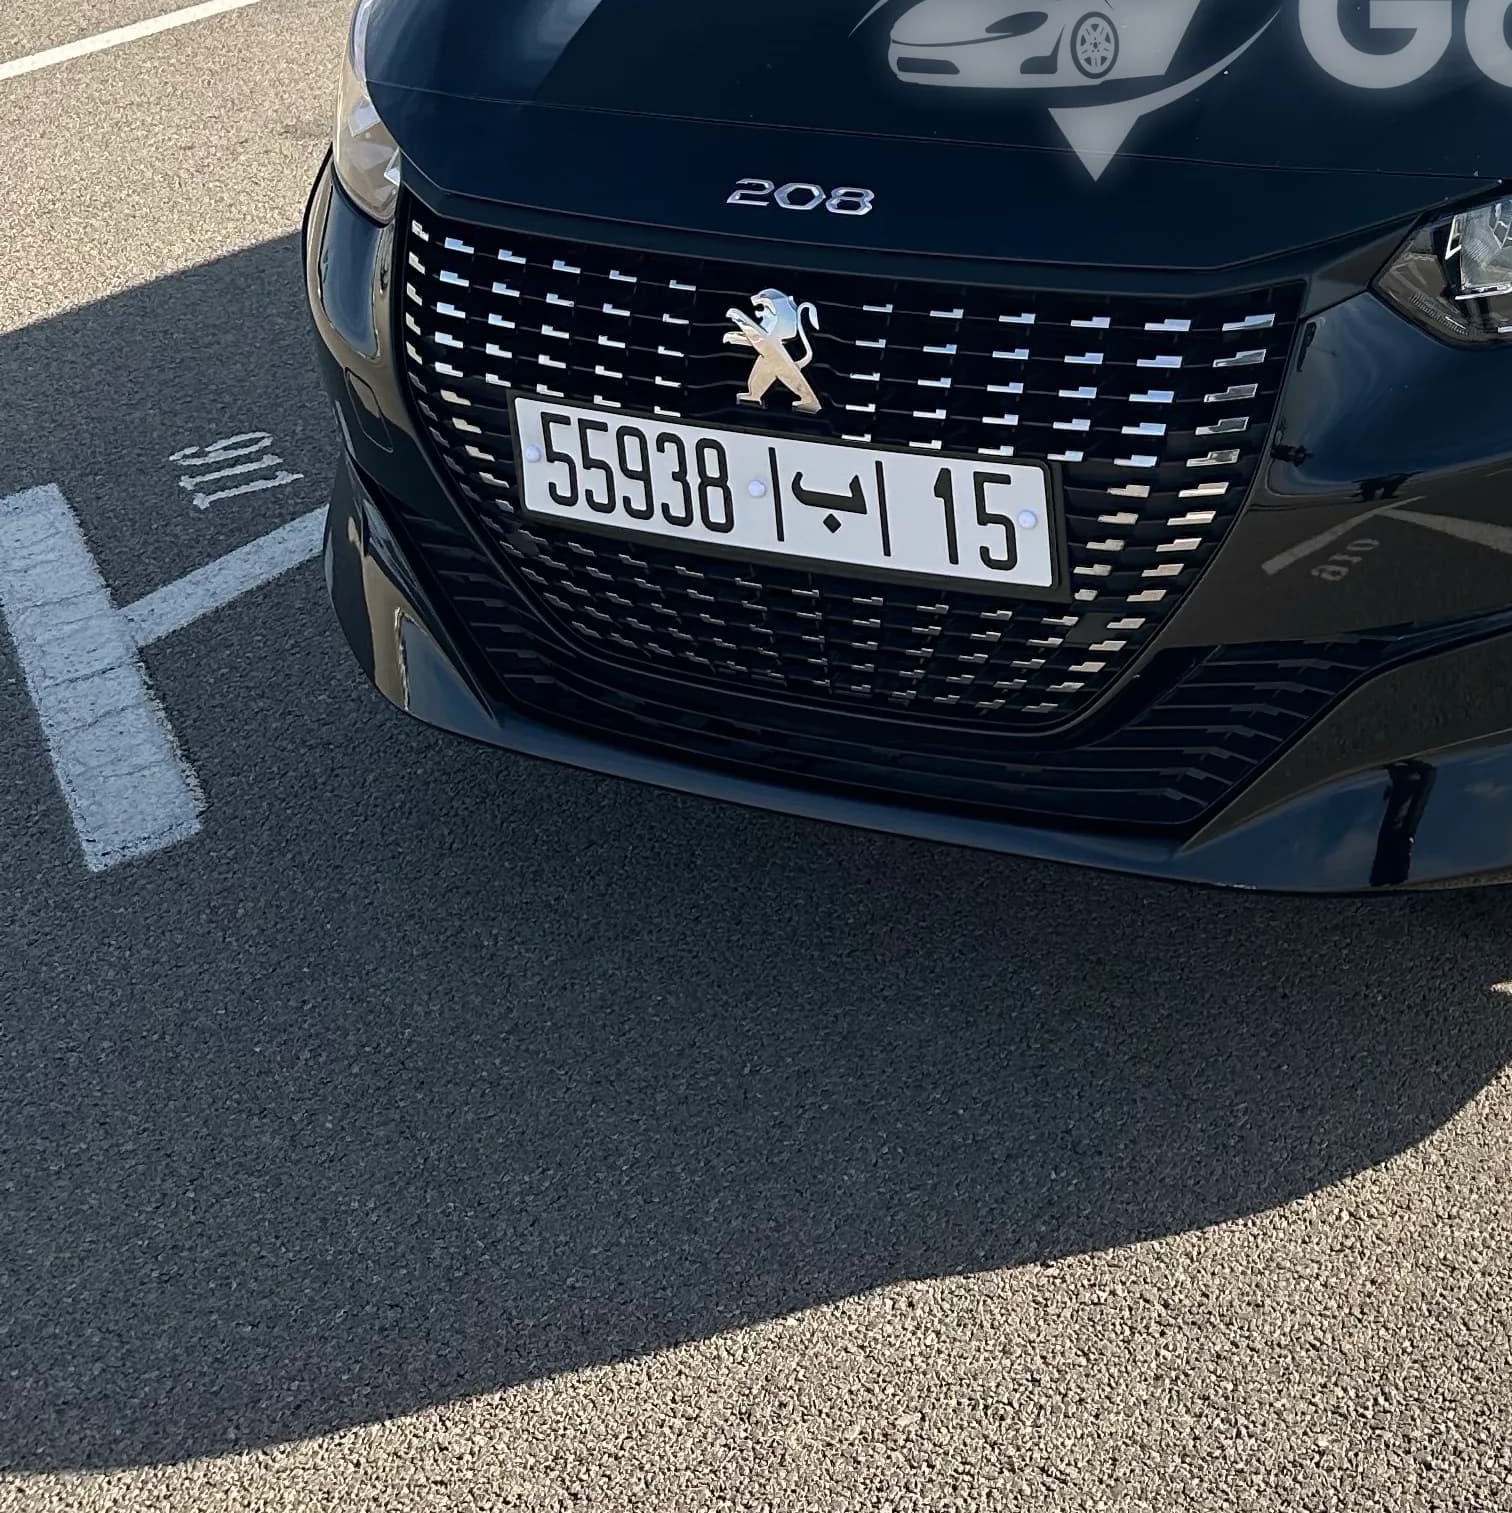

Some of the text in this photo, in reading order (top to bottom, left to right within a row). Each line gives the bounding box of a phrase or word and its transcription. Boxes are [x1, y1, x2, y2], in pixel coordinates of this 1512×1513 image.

[726, 178, 875, 216] 208
[540, 411, 1018, 572] 55938 ب 15
